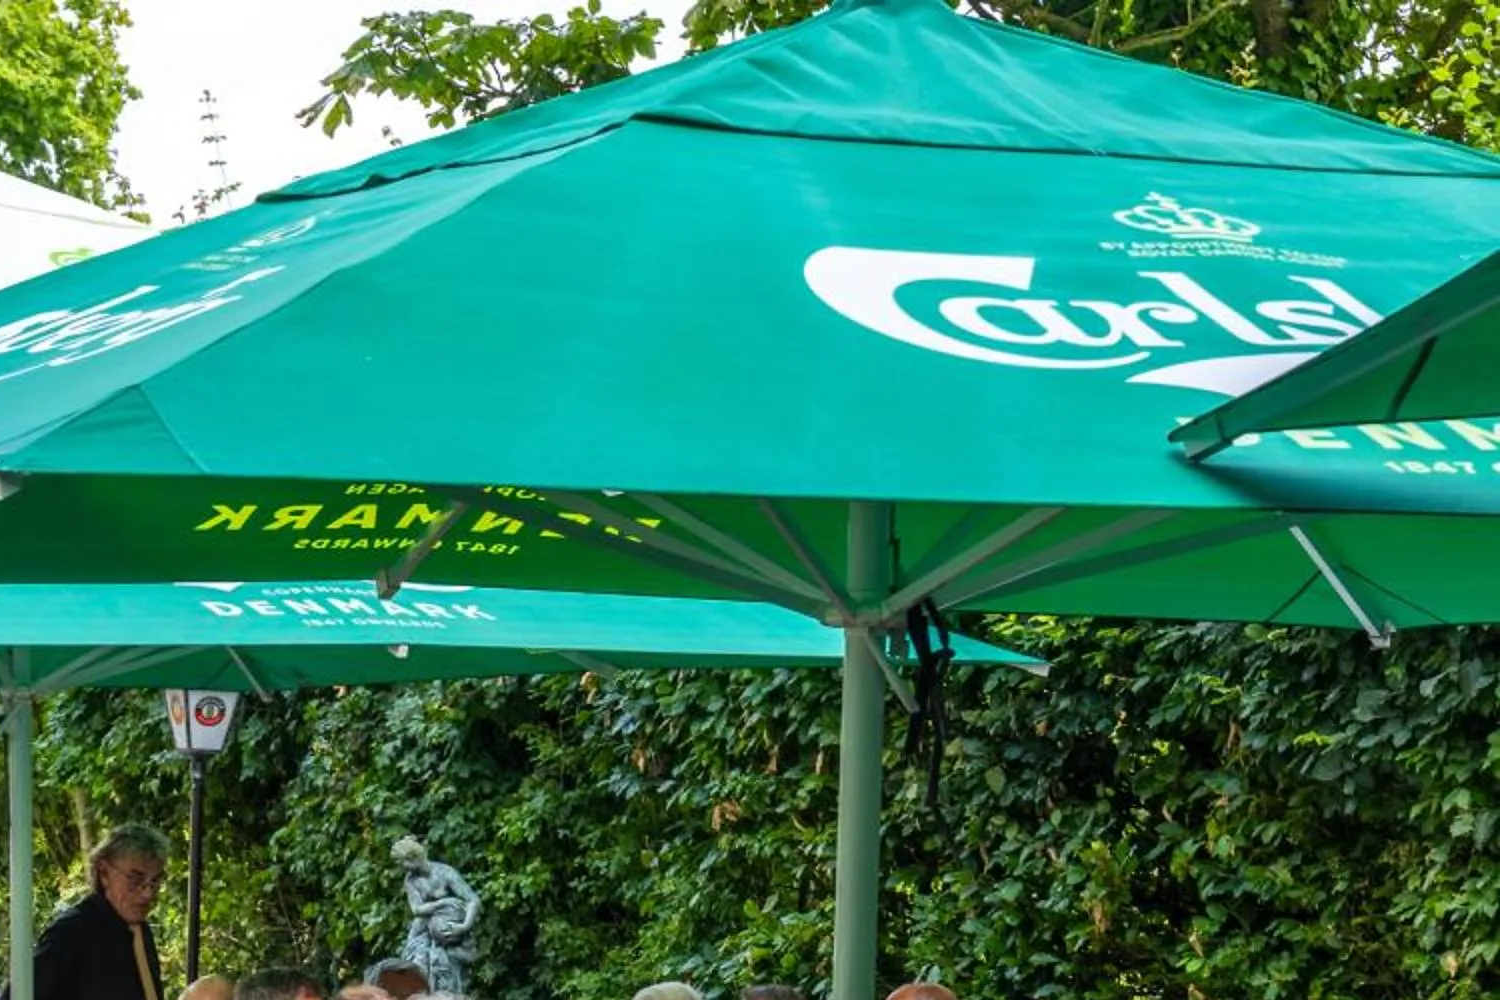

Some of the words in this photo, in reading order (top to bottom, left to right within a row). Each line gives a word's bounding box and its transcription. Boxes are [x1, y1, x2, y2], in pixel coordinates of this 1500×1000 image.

[803, 245, 1386, 369] Carls
[1384, 461, 1477, 474] 1847
[201, 598, 496, 621] DENMARK
